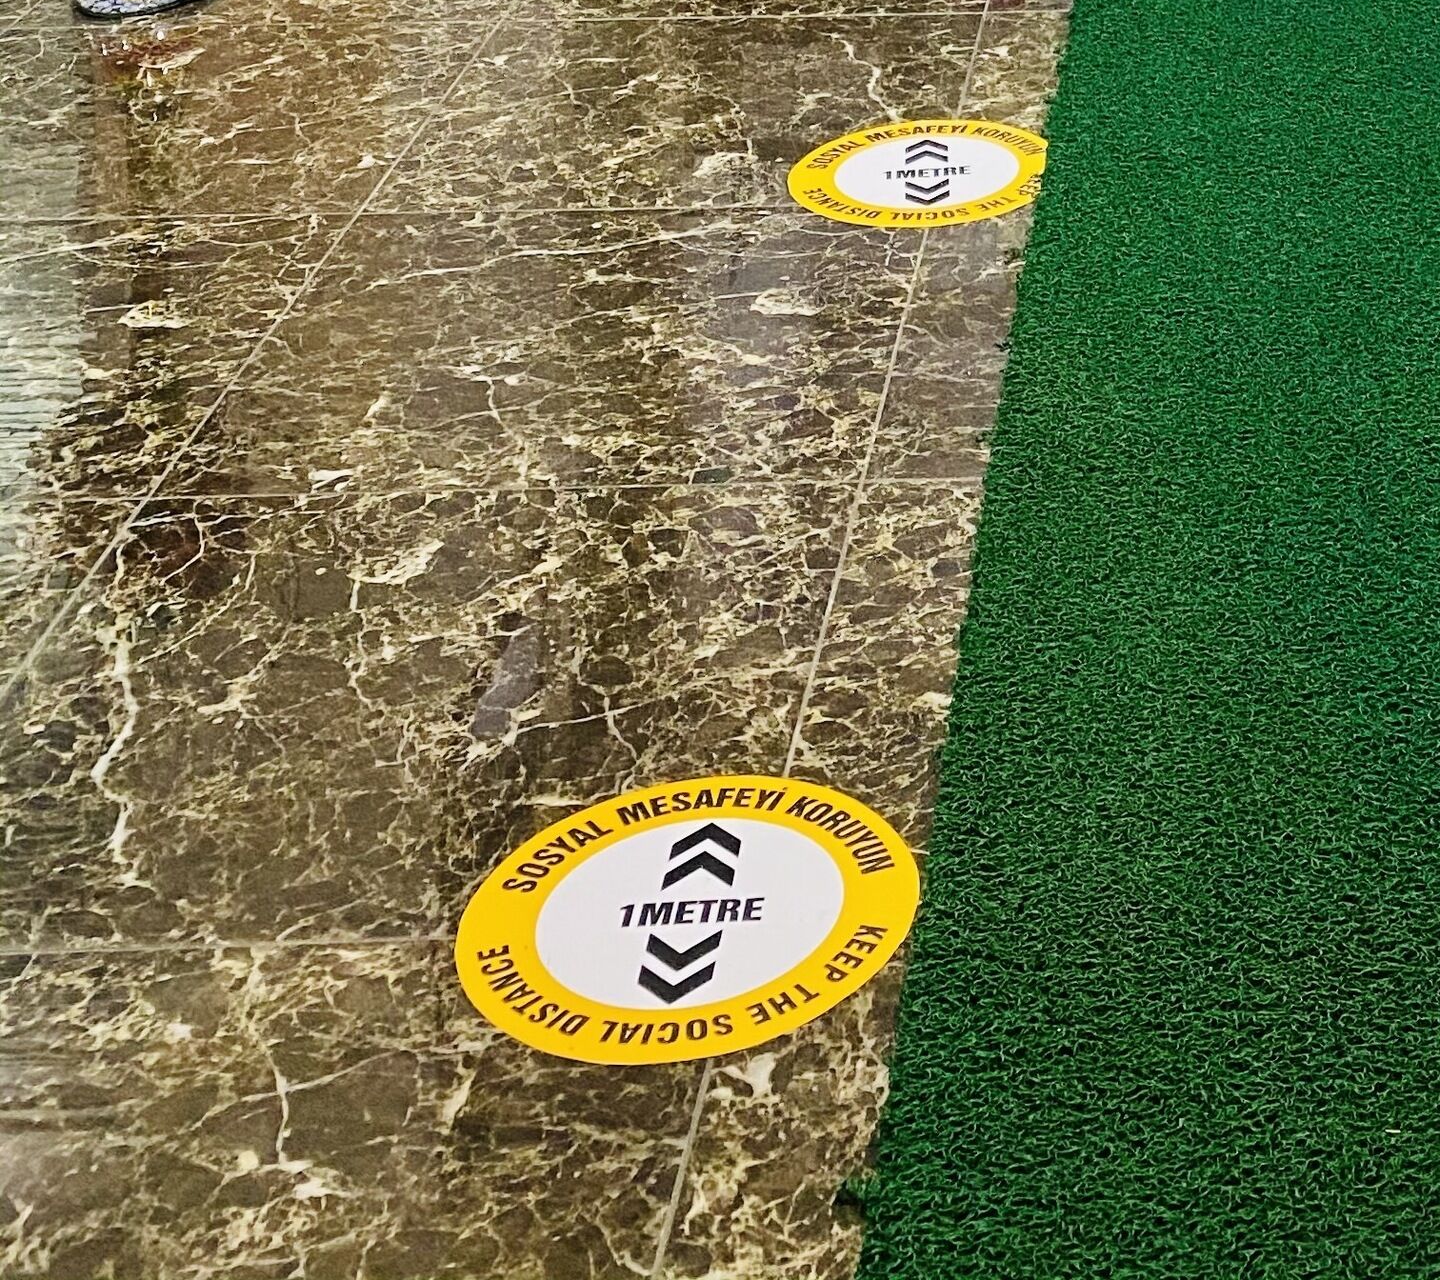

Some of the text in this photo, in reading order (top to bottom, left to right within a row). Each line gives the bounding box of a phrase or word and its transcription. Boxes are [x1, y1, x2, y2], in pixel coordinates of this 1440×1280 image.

[806, 141, 866, 169] SOSYAL
[864, 125, 968, 143] MESAFEYİ
[883, 165, 972, 181] 1METRE
[803, 187, 883, 219] DISTANCE
[891, 207, 970, 220] SOCIAL
[975, 196, 1018, 211] THE
[502, 787, 897, 894] SOSYAL MESAFEYİ KORUYUN
[619, 896, 766, 928] 1METRE
[476, 924, 888, 1045] KEEP THE SOCIAL DISTANCE
